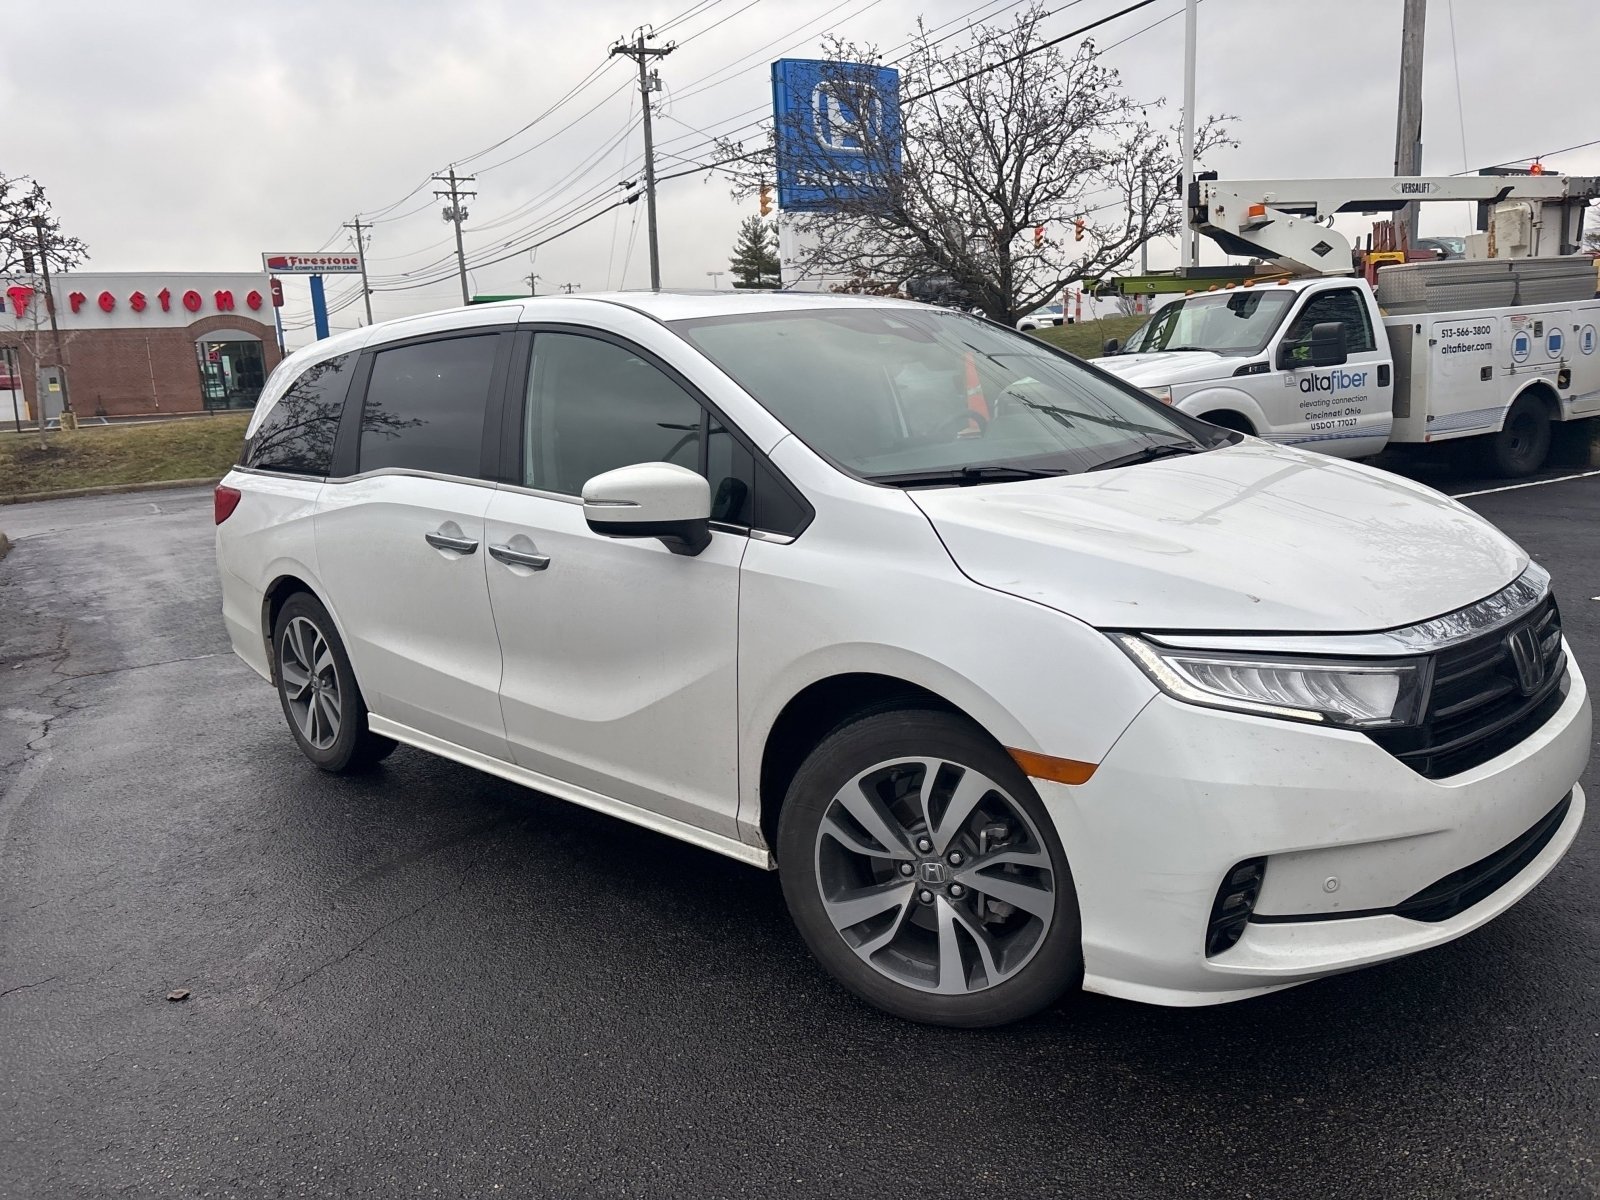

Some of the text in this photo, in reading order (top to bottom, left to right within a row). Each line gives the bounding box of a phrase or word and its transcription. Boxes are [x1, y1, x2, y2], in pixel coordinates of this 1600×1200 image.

[1401, 182, 1431, 194] VERSALIFT
[288, 256, 360, 266] Firestone
[6, 286, 263, 319] Frestone
[1441, 325, 1491, 339] 513-566-3800
[1441, 342, 1493, 355] altafiber.com
[1299, 370, 1368, 395] altafiber
[1299, 394, 1368, 409] elevating connection
[1304, 407, 1362, 421] Cincinnati Ohio
[1310, 418, 1358, 431] USDOT 77027
